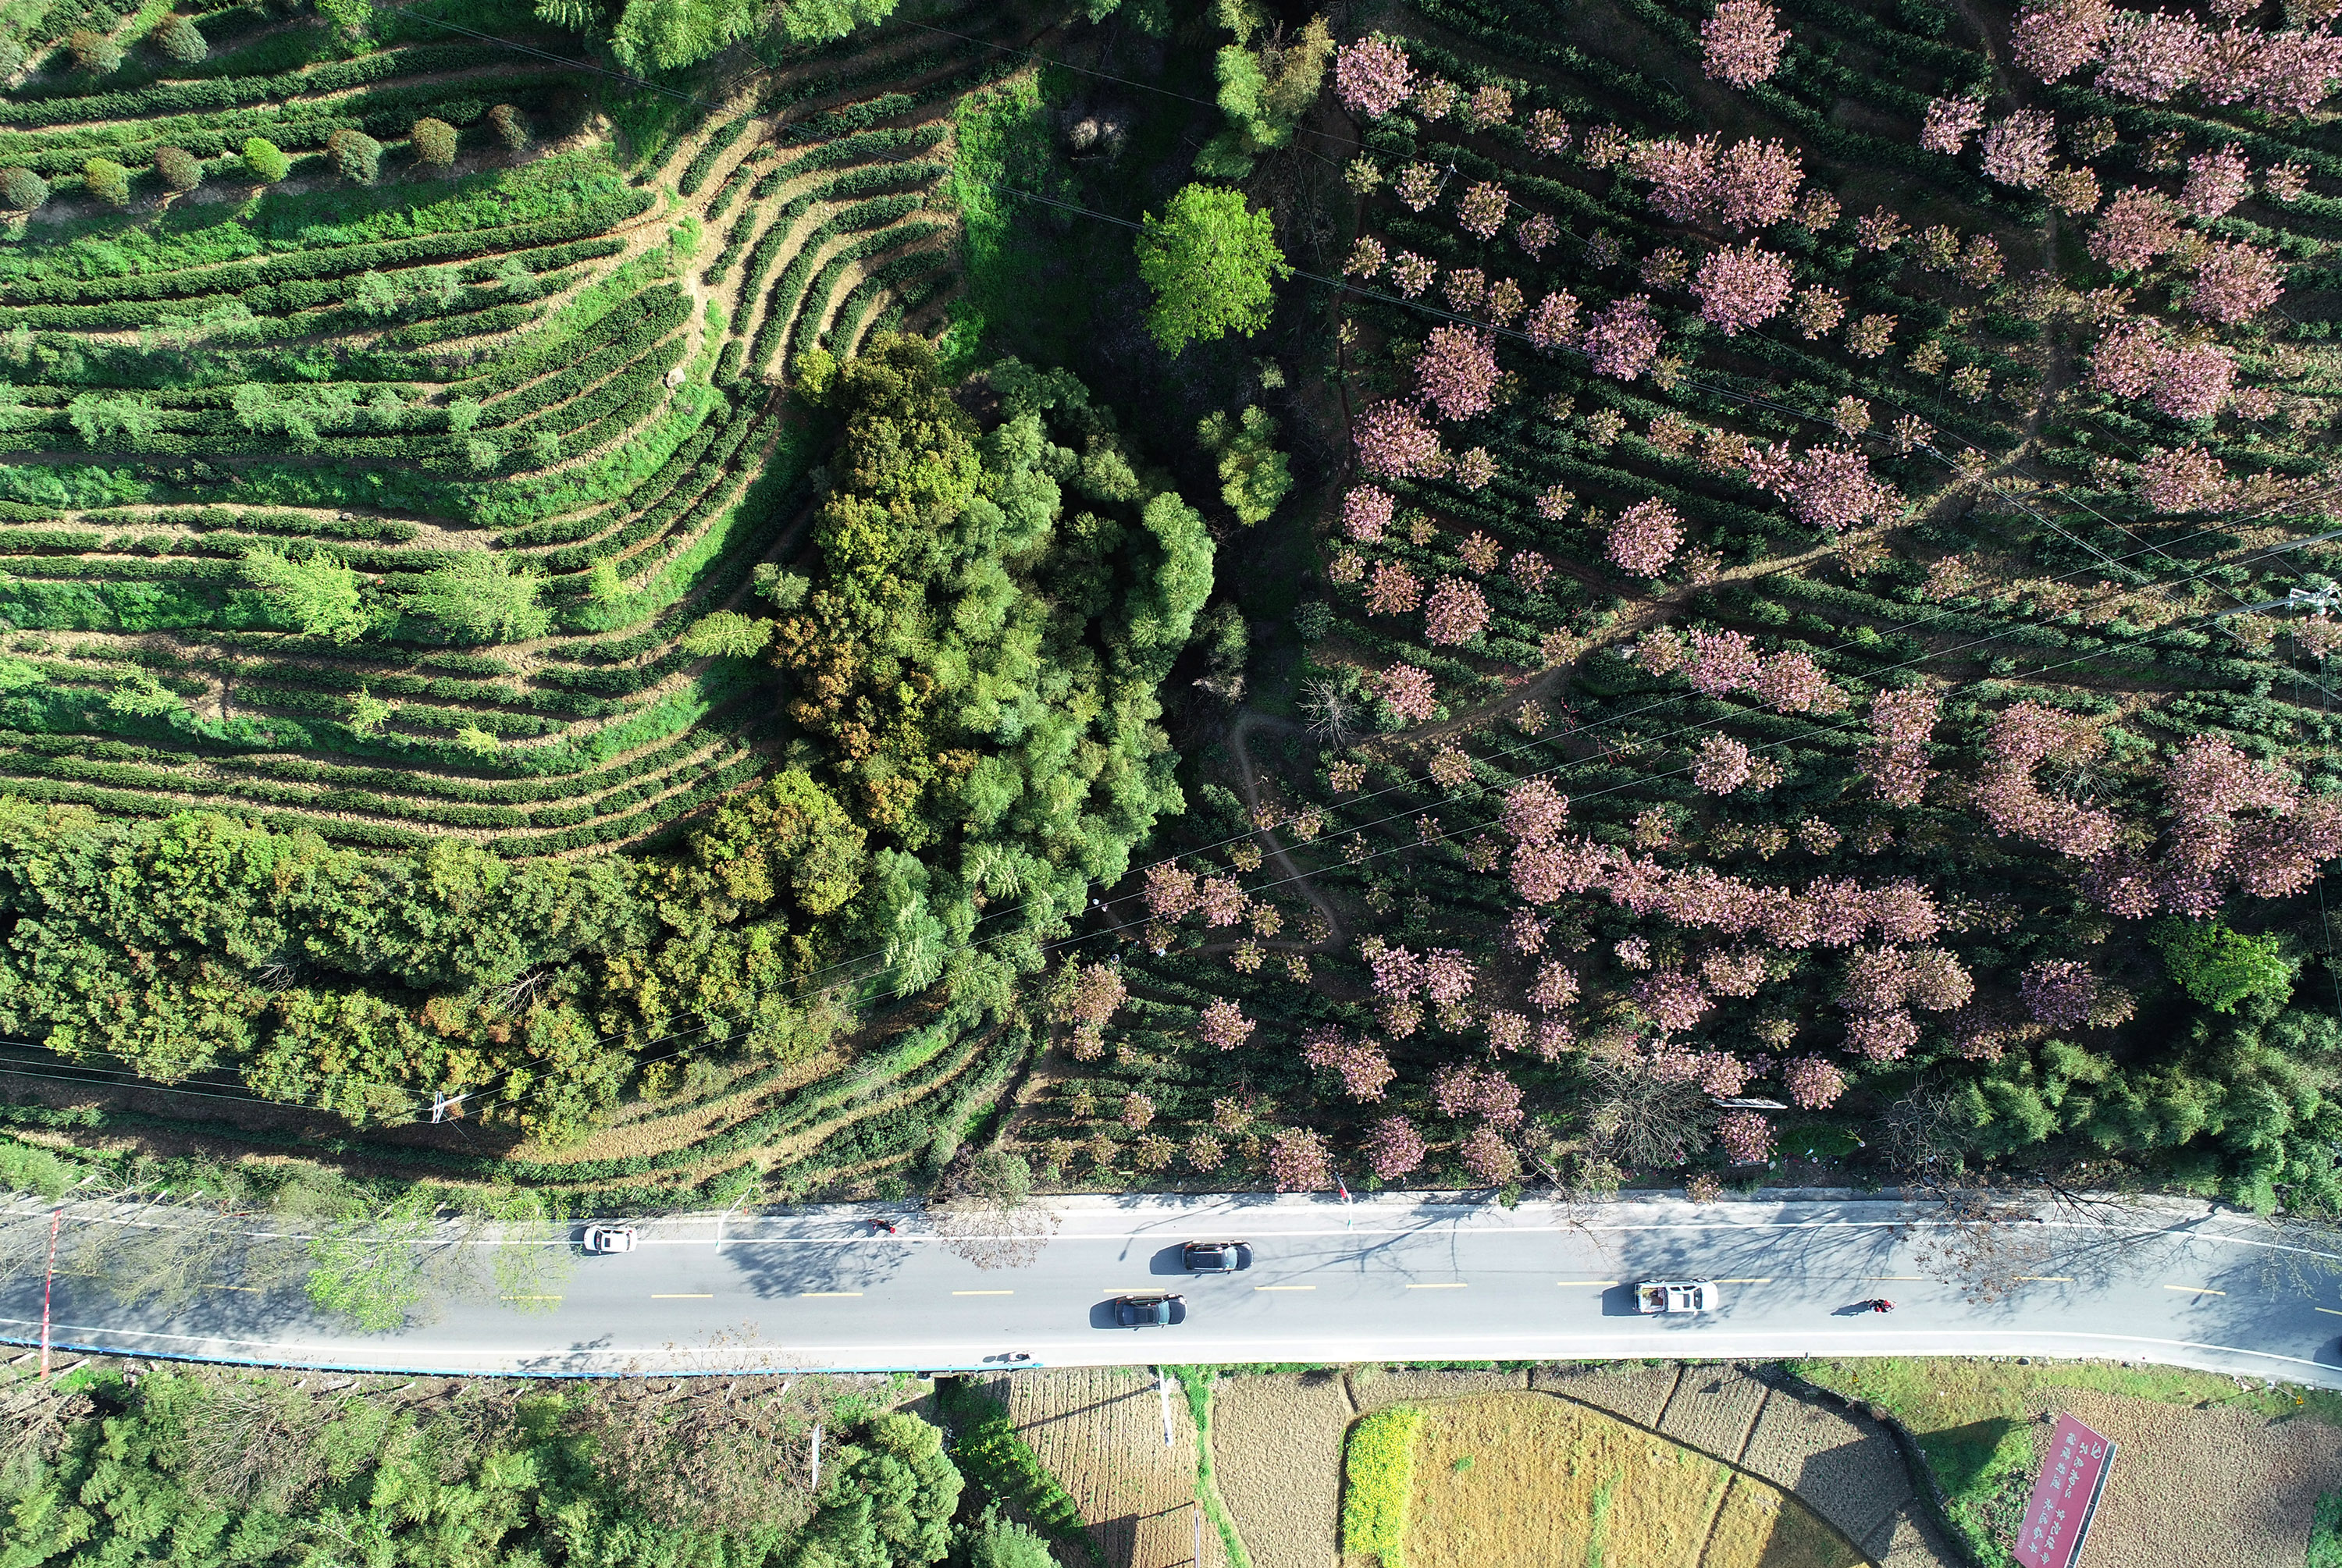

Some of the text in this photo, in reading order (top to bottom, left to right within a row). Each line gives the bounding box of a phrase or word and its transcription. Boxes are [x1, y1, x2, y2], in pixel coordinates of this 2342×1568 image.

[2028, 1431, 2077, 1553] 继续前进 永远奋斗
[2040, 1442, 2088, 1565] 不忘初心 牢记使命
